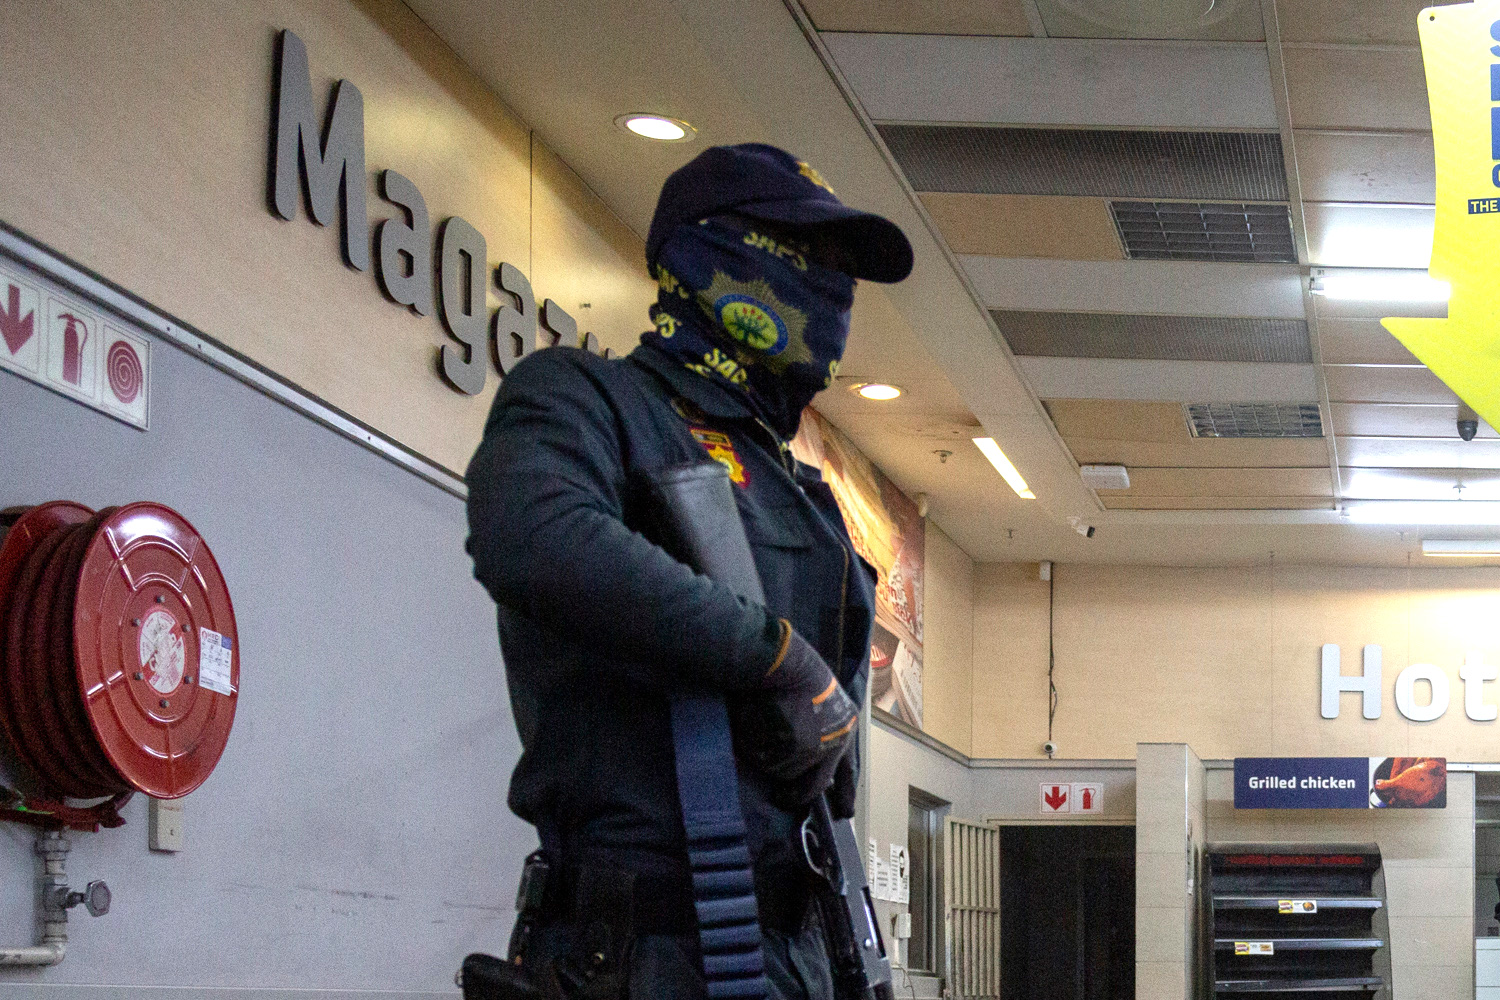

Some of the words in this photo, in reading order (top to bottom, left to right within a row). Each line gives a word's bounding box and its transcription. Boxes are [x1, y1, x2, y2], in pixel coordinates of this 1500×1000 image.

[269, 28, 616, 396] Magaz
[1471, 199, 1499, 213] THE
[1319, 643, 1498, 722] Hot
[1249, 776, 1296, 789] Grilled
[1300, 776, 1356, 789] chicken
